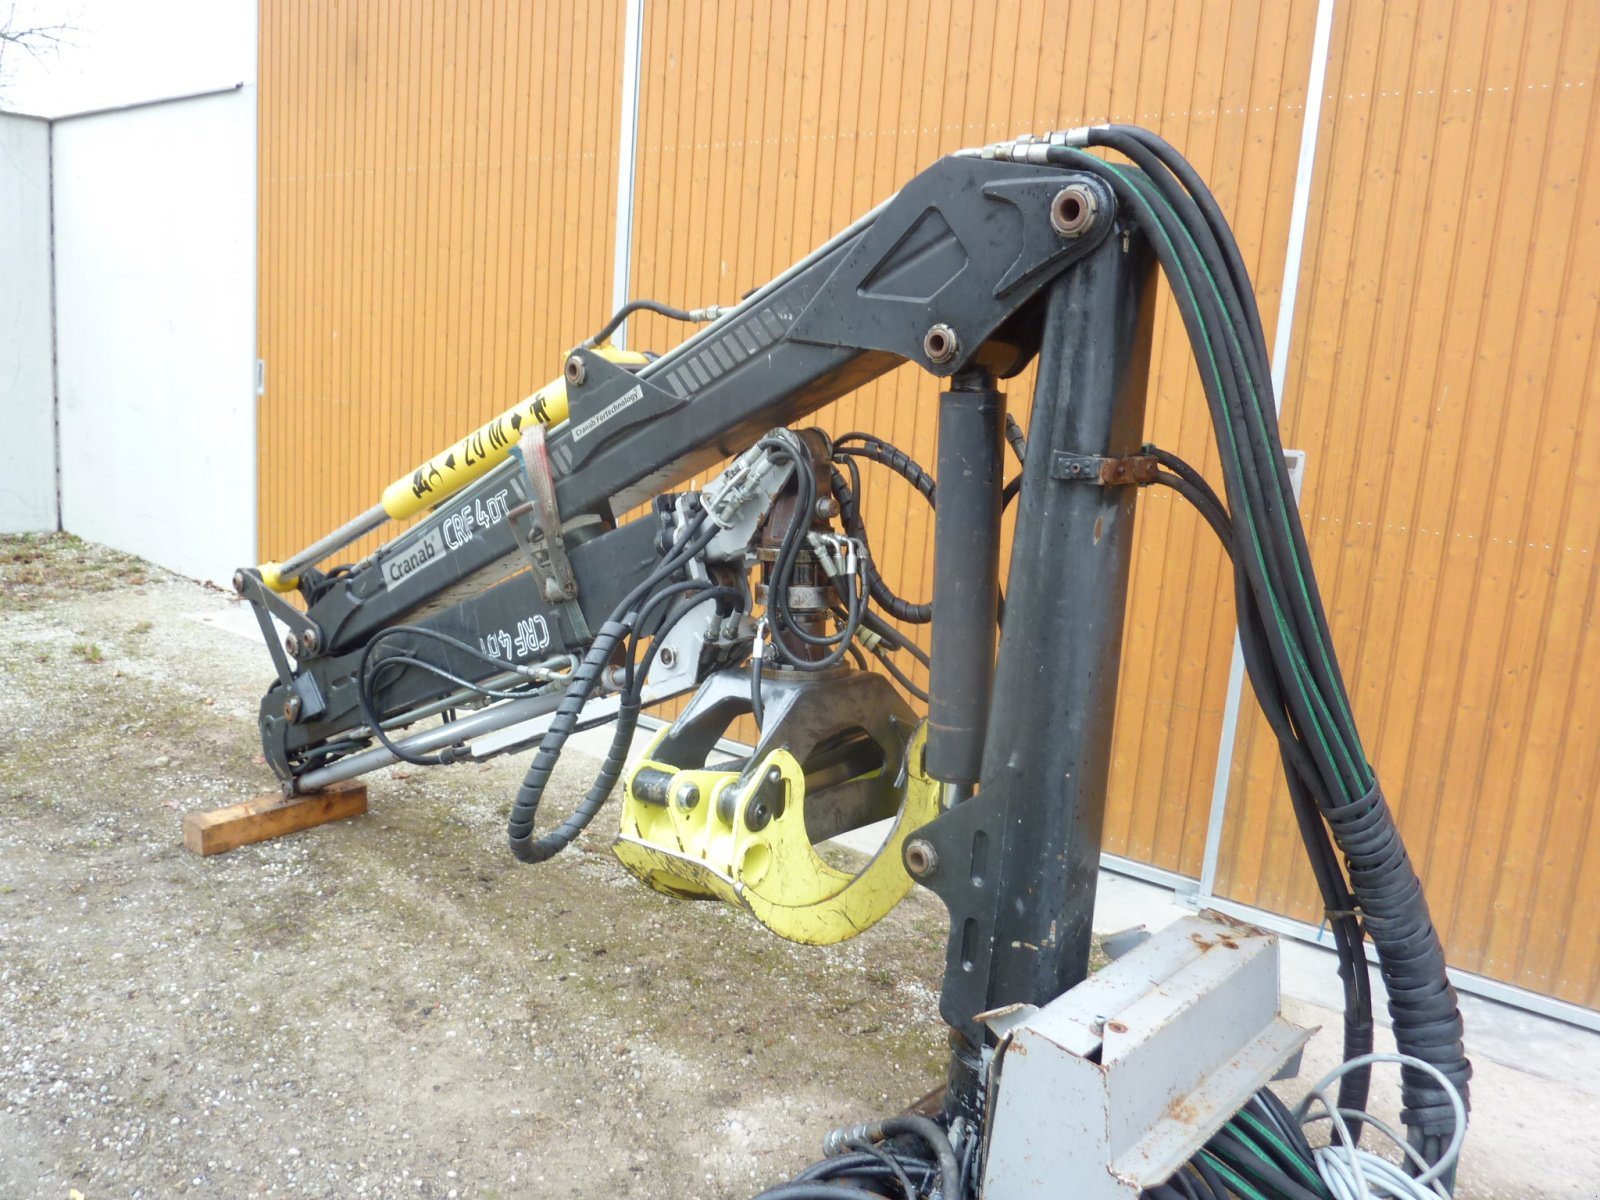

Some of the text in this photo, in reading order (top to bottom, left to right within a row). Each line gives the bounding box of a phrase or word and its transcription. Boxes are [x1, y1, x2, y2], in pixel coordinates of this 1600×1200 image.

[596, 391, 639, 424] Fortechnology
[464, 418, 508, 466] 20 M
[389, 540, 435, 581] Cranab
